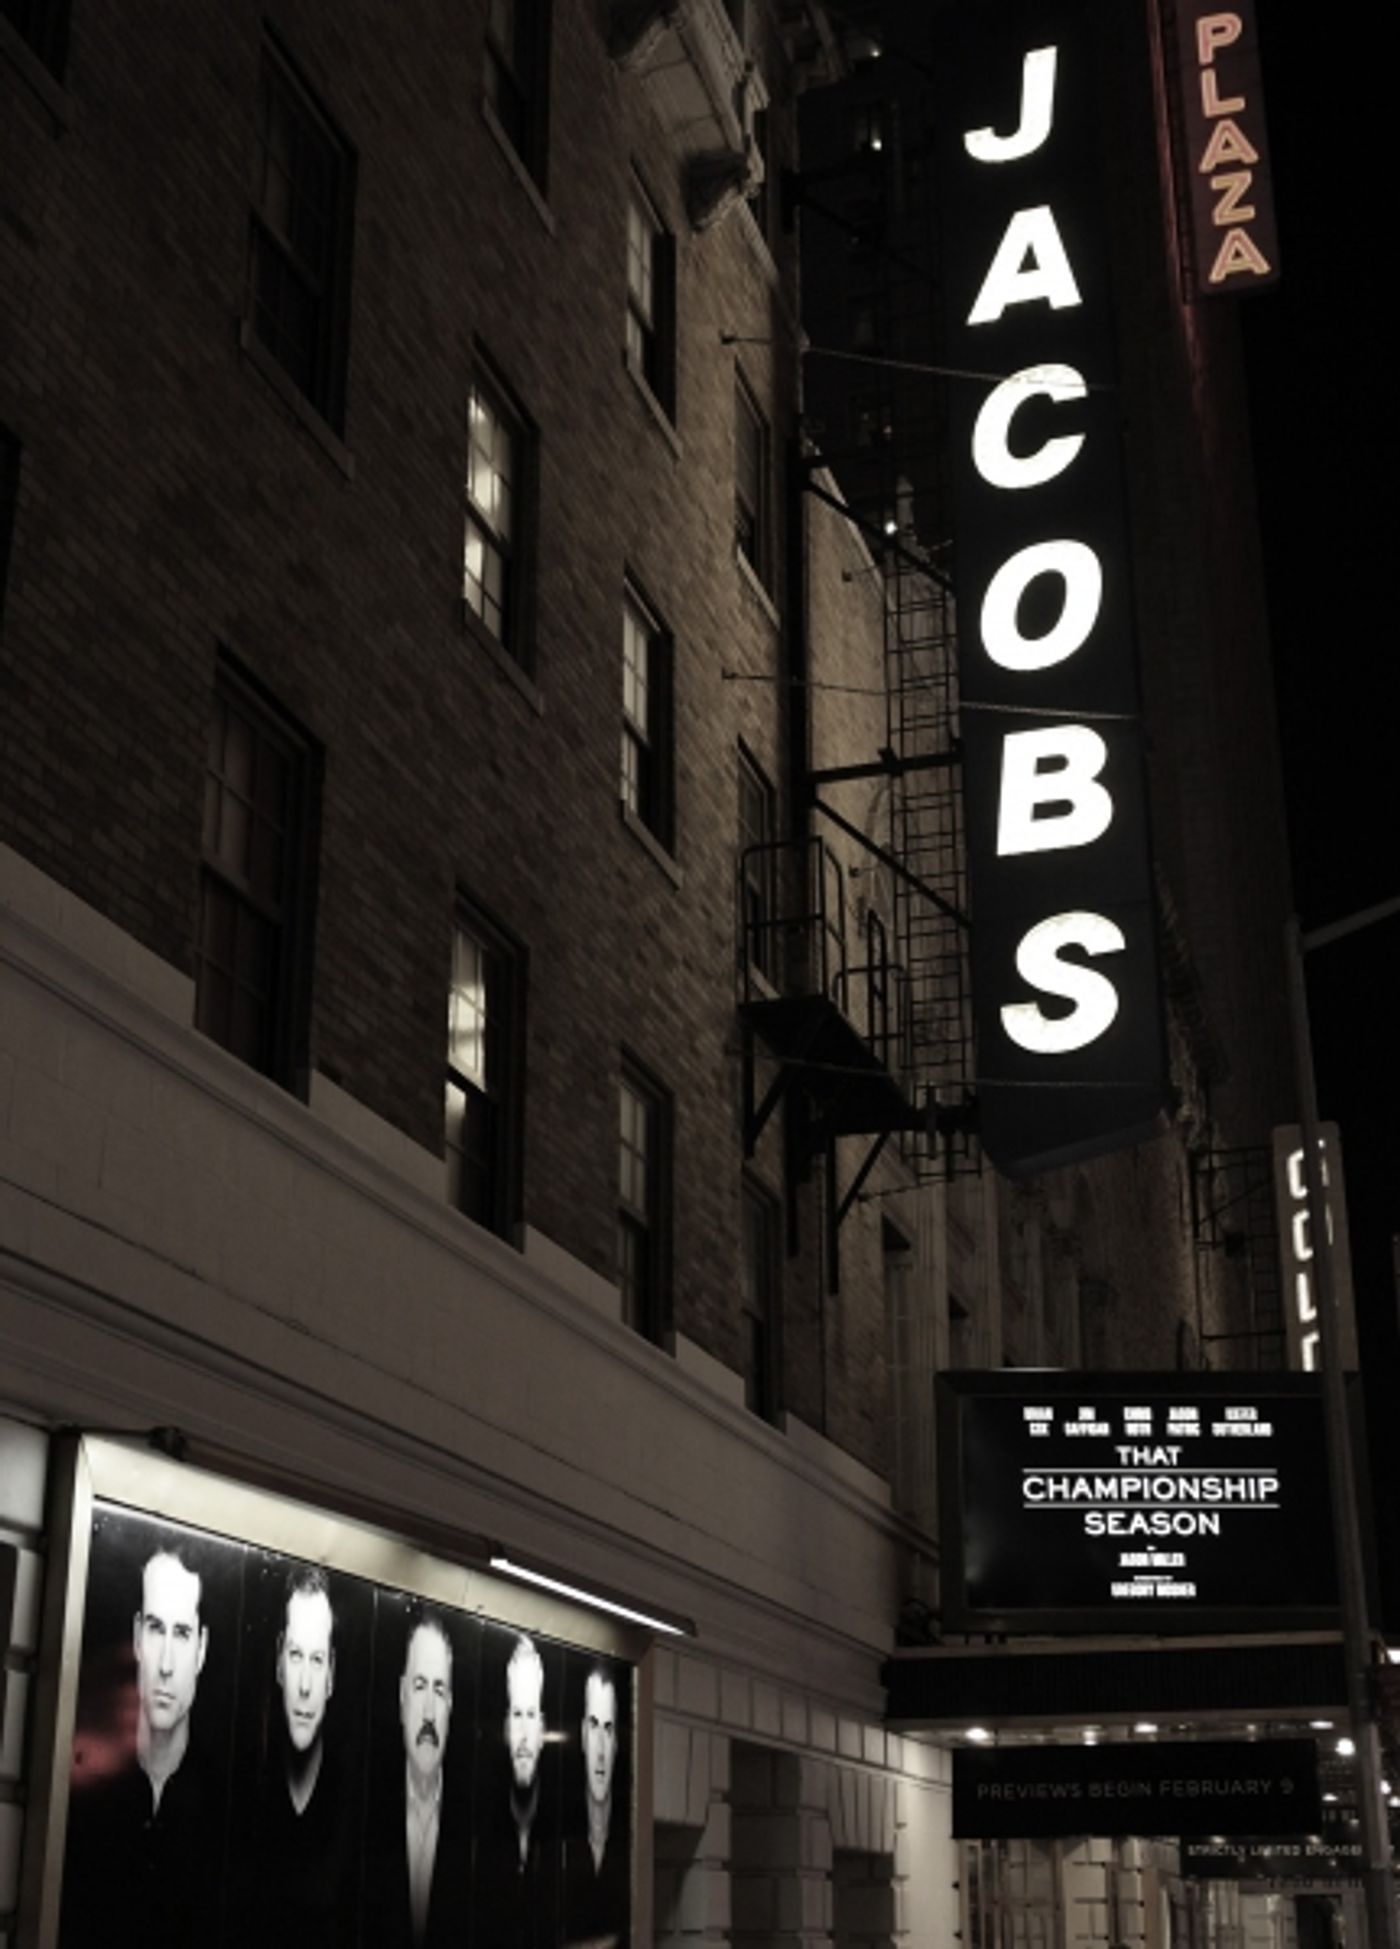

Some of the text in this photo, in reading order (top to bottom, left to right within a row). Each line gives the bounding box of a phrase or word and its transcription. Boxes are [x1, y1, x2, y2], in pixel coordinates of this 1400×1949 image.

[1196, 12, 1276, 284] PLAZA
[964, 46, 1126, 1053] JACOBS
[1115, 1446, 1182, 1466] THAT
[1022, 1475, 1280, 1501] CHAMPIONSHIP
[1084, 1511, 1221, 1536] SEASON
[976, 1782, 1081, 1800] PREVIEWS
[1088, 1781, 1153, 1798] BEGIN
[1159, 1779, 1271, 1798] FEBRUARY
